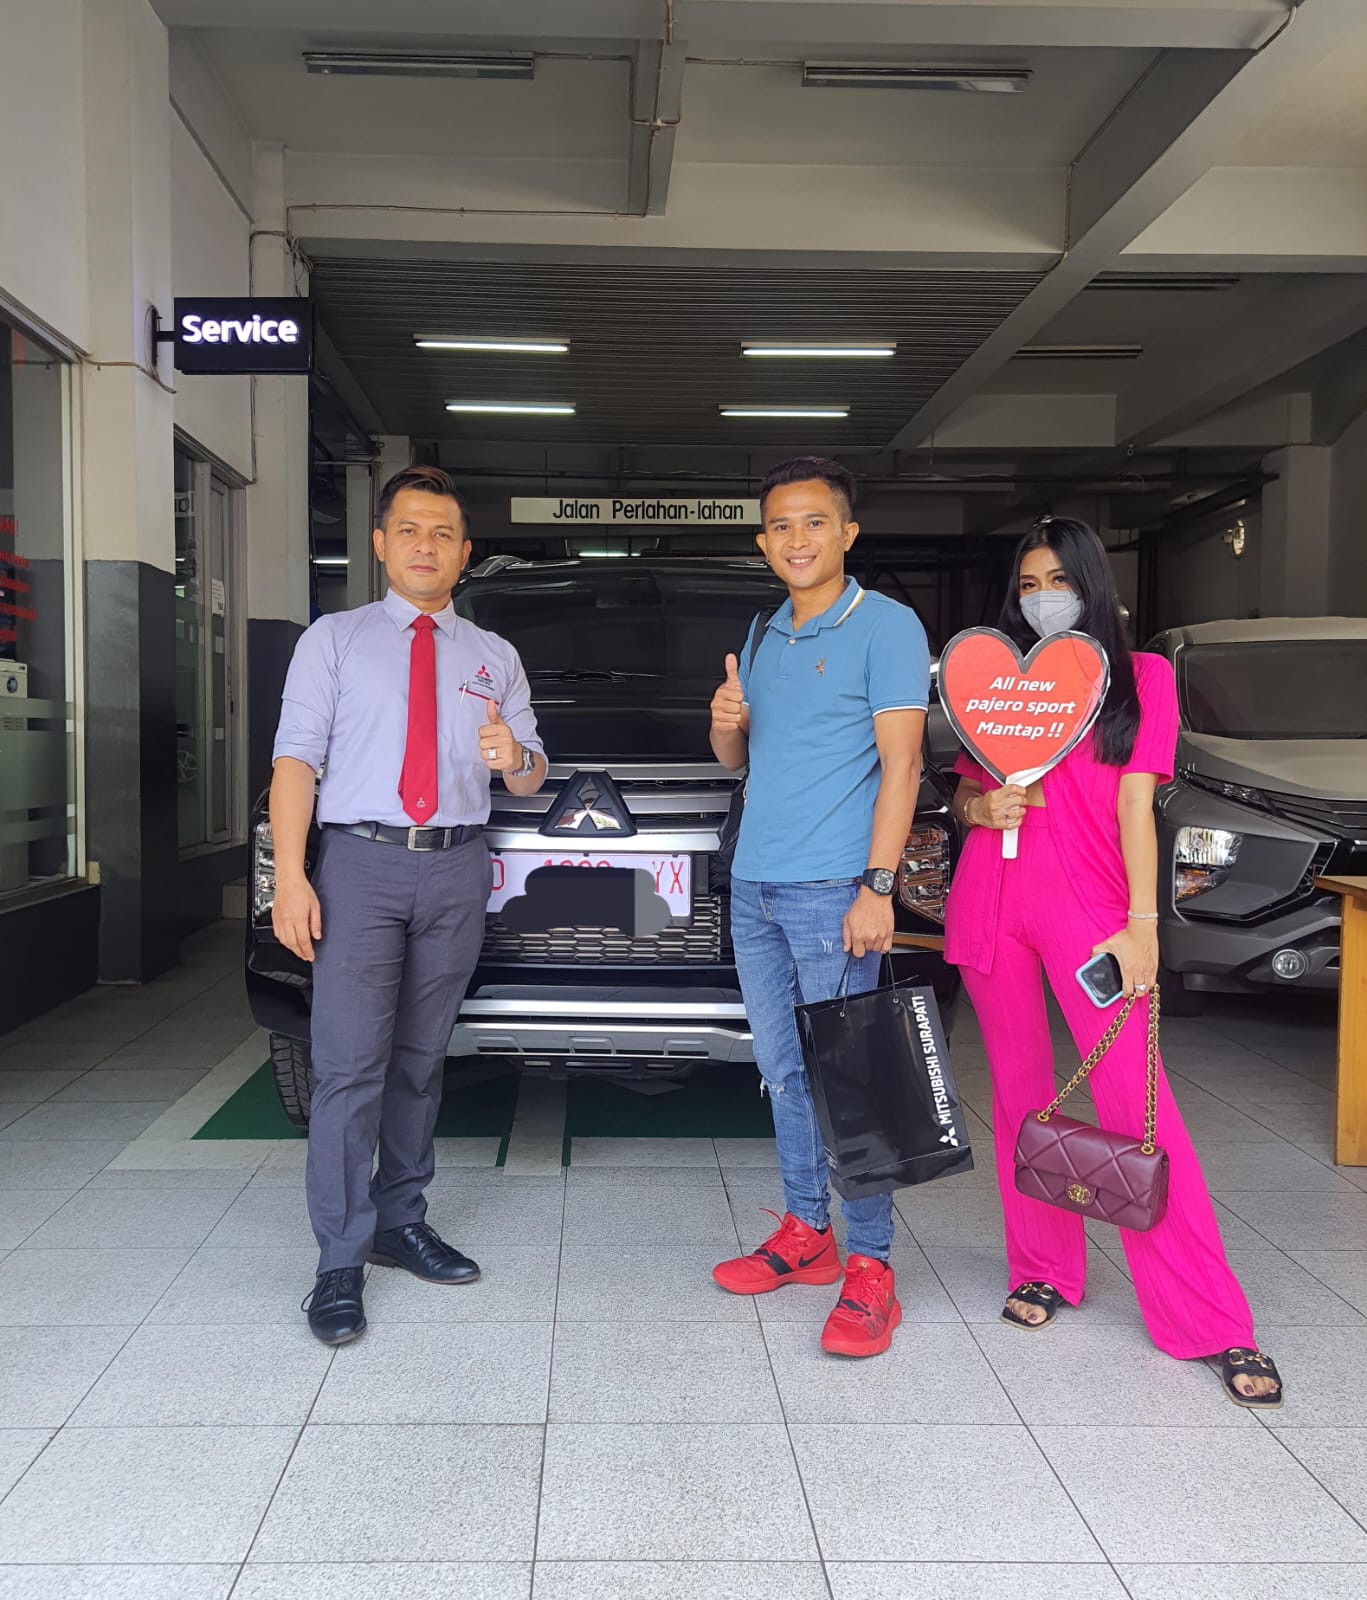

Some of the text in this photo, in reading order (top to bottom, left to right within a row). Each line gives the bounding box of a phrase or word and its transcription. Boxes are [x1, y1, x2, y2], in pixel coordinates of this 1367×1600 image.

[182, 314, 298, 343] Service
[553, 499, 744, 520] Jalan Perlahan-lahan
[989, 676, 1056, 692] All new
[965, 697, 1076, 716] pajero sport
[976, 721, 1065, 740] Mantap !!
[911, 996, 953, 1126] MITSUBISHI SURAPATI
